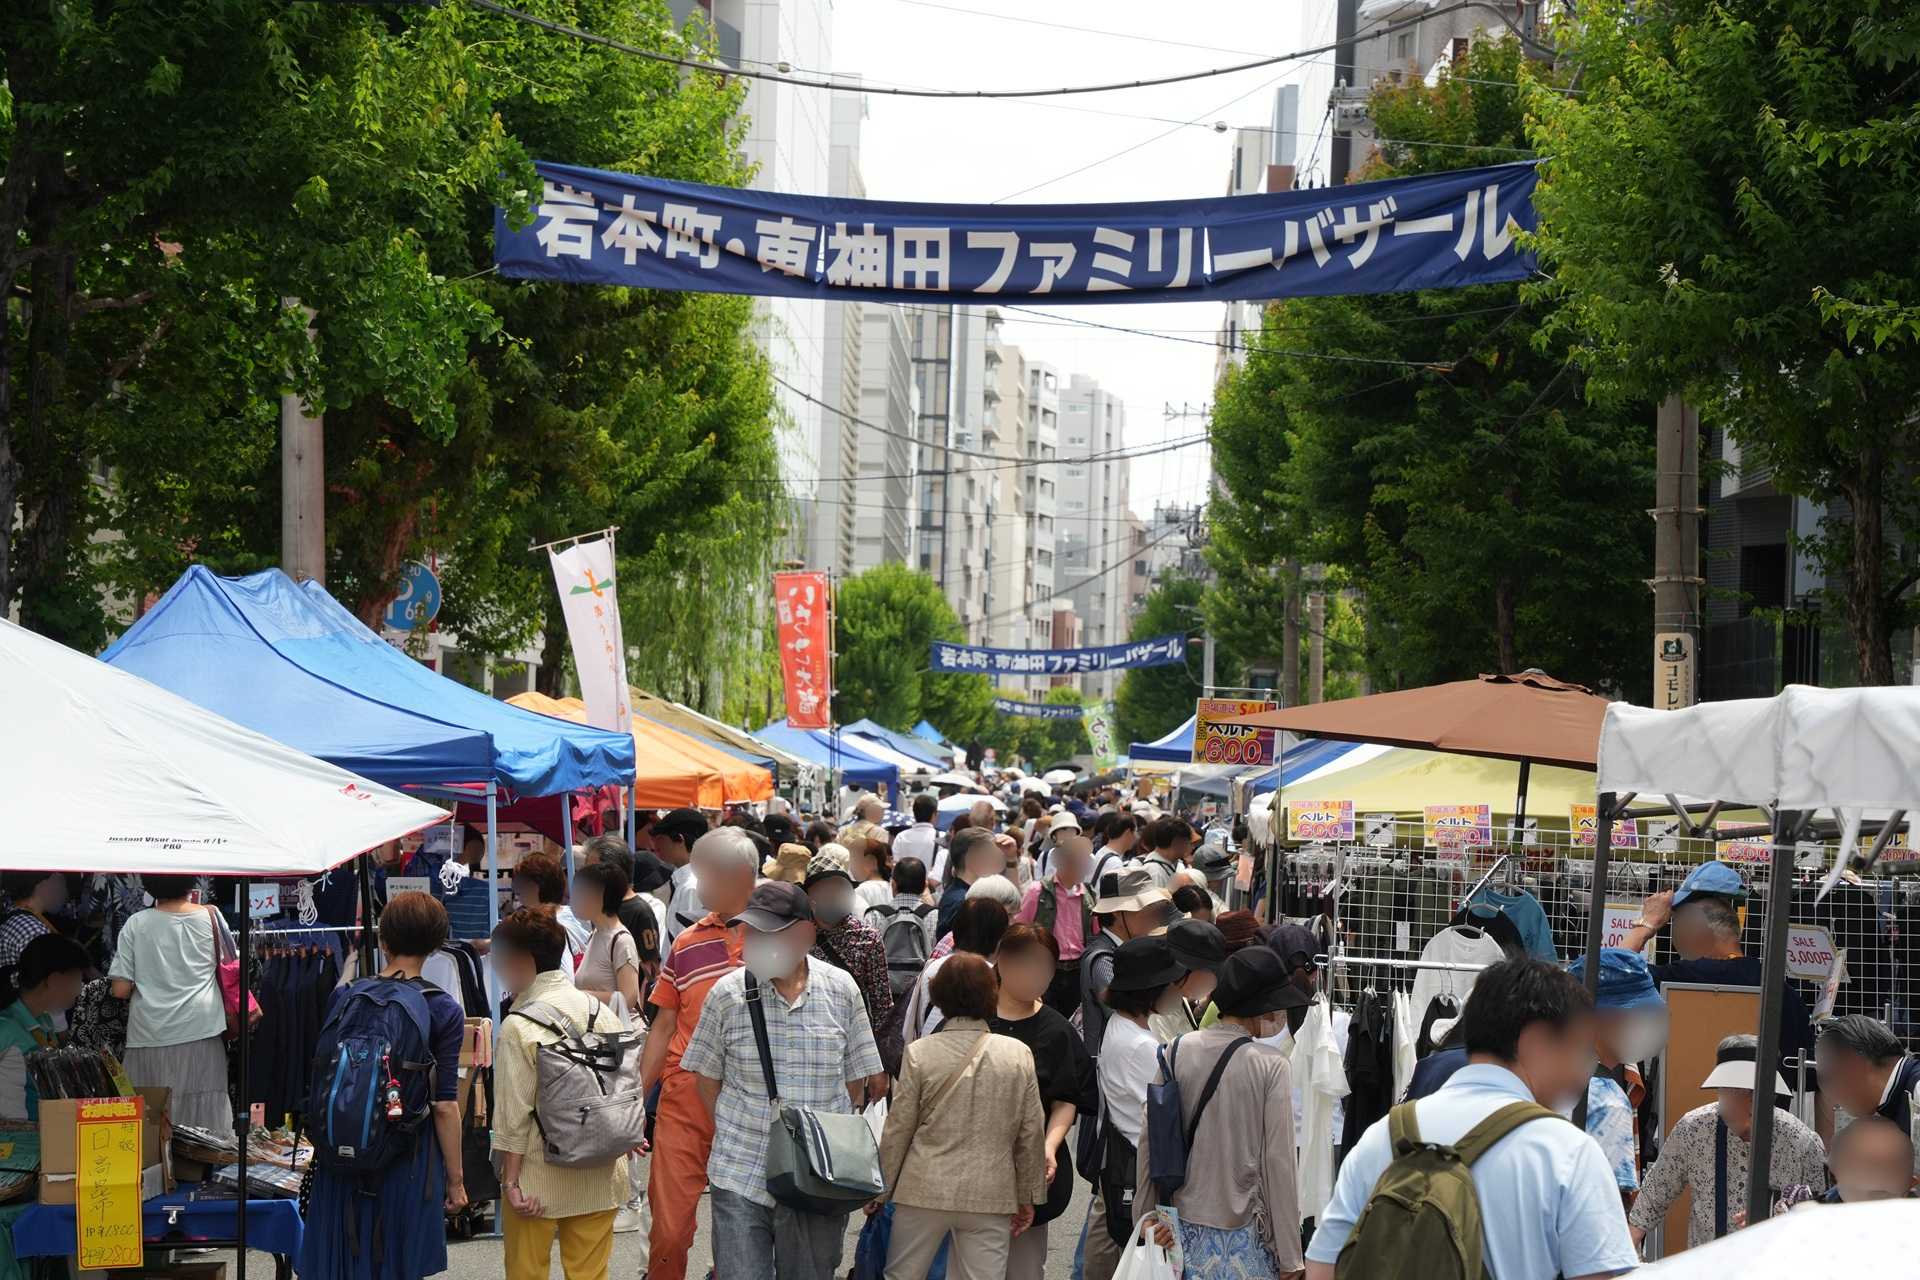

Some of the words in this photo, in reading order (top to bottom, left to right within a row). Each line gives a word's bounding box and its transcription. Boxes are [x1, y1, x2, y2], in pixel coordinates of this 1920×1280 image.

[1300, 812, 1334, 821] ベルト
[1437, 817, 1472, 826] ベルト
[1611, 918, 1633, 929] SALE
[1792, 936, 1817, 947] SALE
